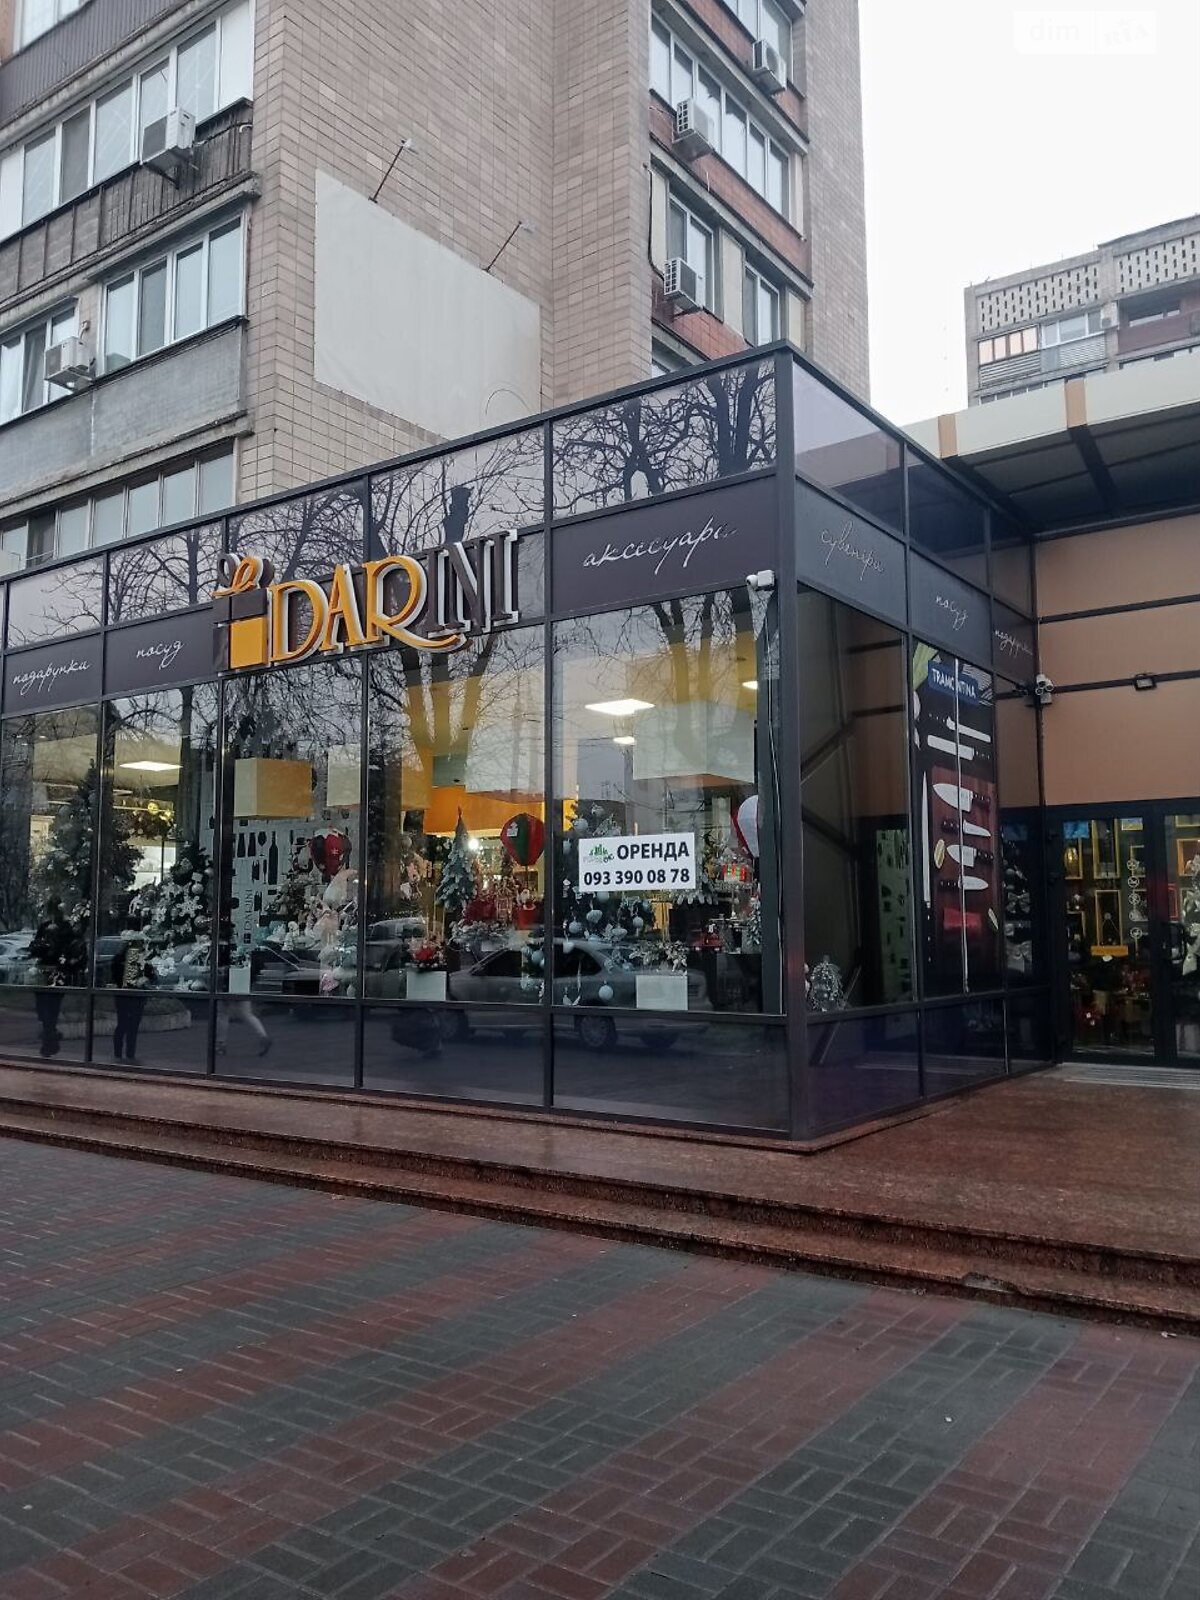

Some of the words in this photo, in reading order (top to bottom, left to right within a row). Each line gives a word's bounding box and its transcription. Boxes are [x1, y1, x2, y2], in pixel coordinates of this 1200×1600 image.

[268, 529, 519, 664] DARINI
[135, 639, 185, 671] посуд
[994, 629, 1034, 658] подару
[12, 659, 91, 696] подарунки
[616, 841, 690, 862] ОРЕНДА
[583, 870, 611, 886] 093
[615, 869, 644, 885] 390
[646, 868, 666, 884] 08
[670, 867, 690, 883] 78
